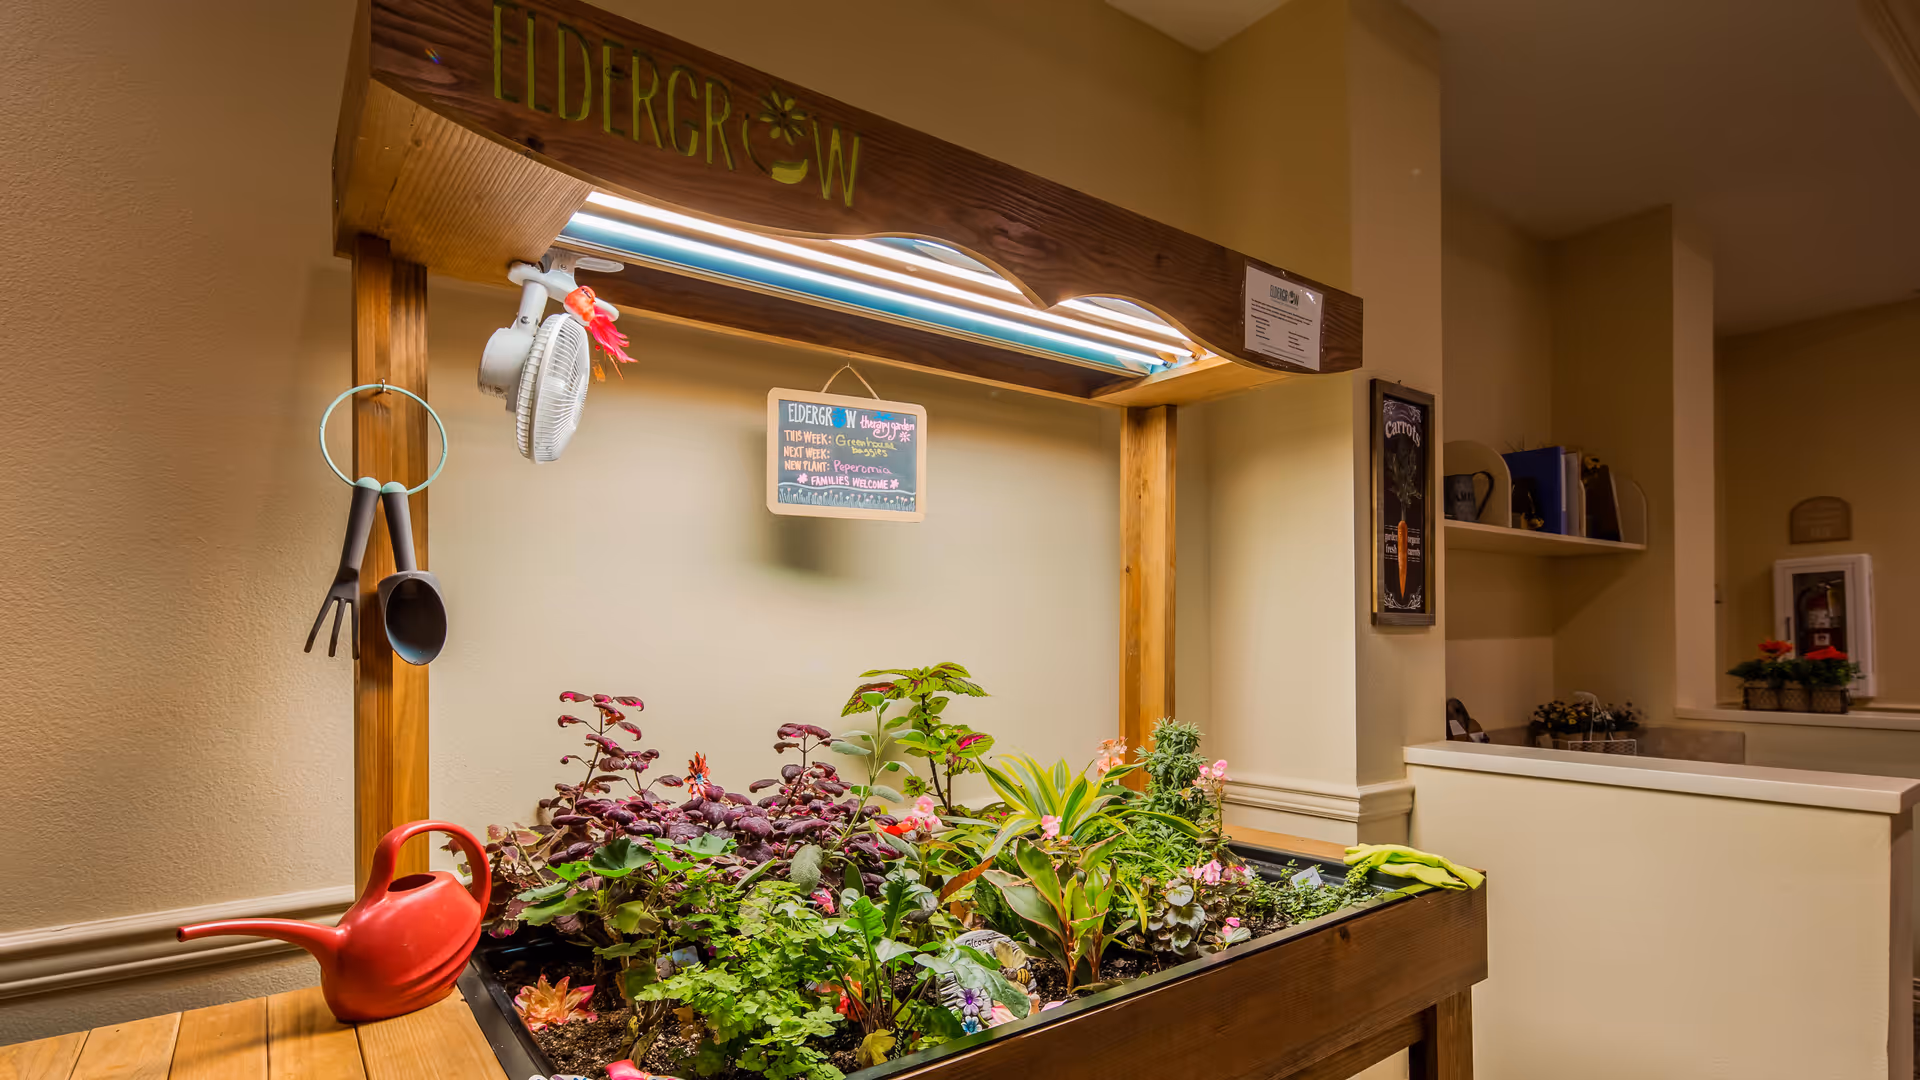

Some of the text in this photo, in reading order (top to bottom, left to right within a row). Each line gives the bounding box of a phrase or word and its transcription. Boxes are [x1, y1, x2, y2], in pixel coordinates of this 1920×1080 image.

[860, 415, 915, 440] therapy garden
[1385, 420, 1421, 448] Carrots
[783, 429, 803, 442] THIS
[803, 431, 832, 446] WEEK:
[783, 445, 831, 460] NEXT WEEK:
[784, 459, 893, 475] NEW PLANT: Peperomia
[811, 475, 889, 490] FAMILIES WELCOME
